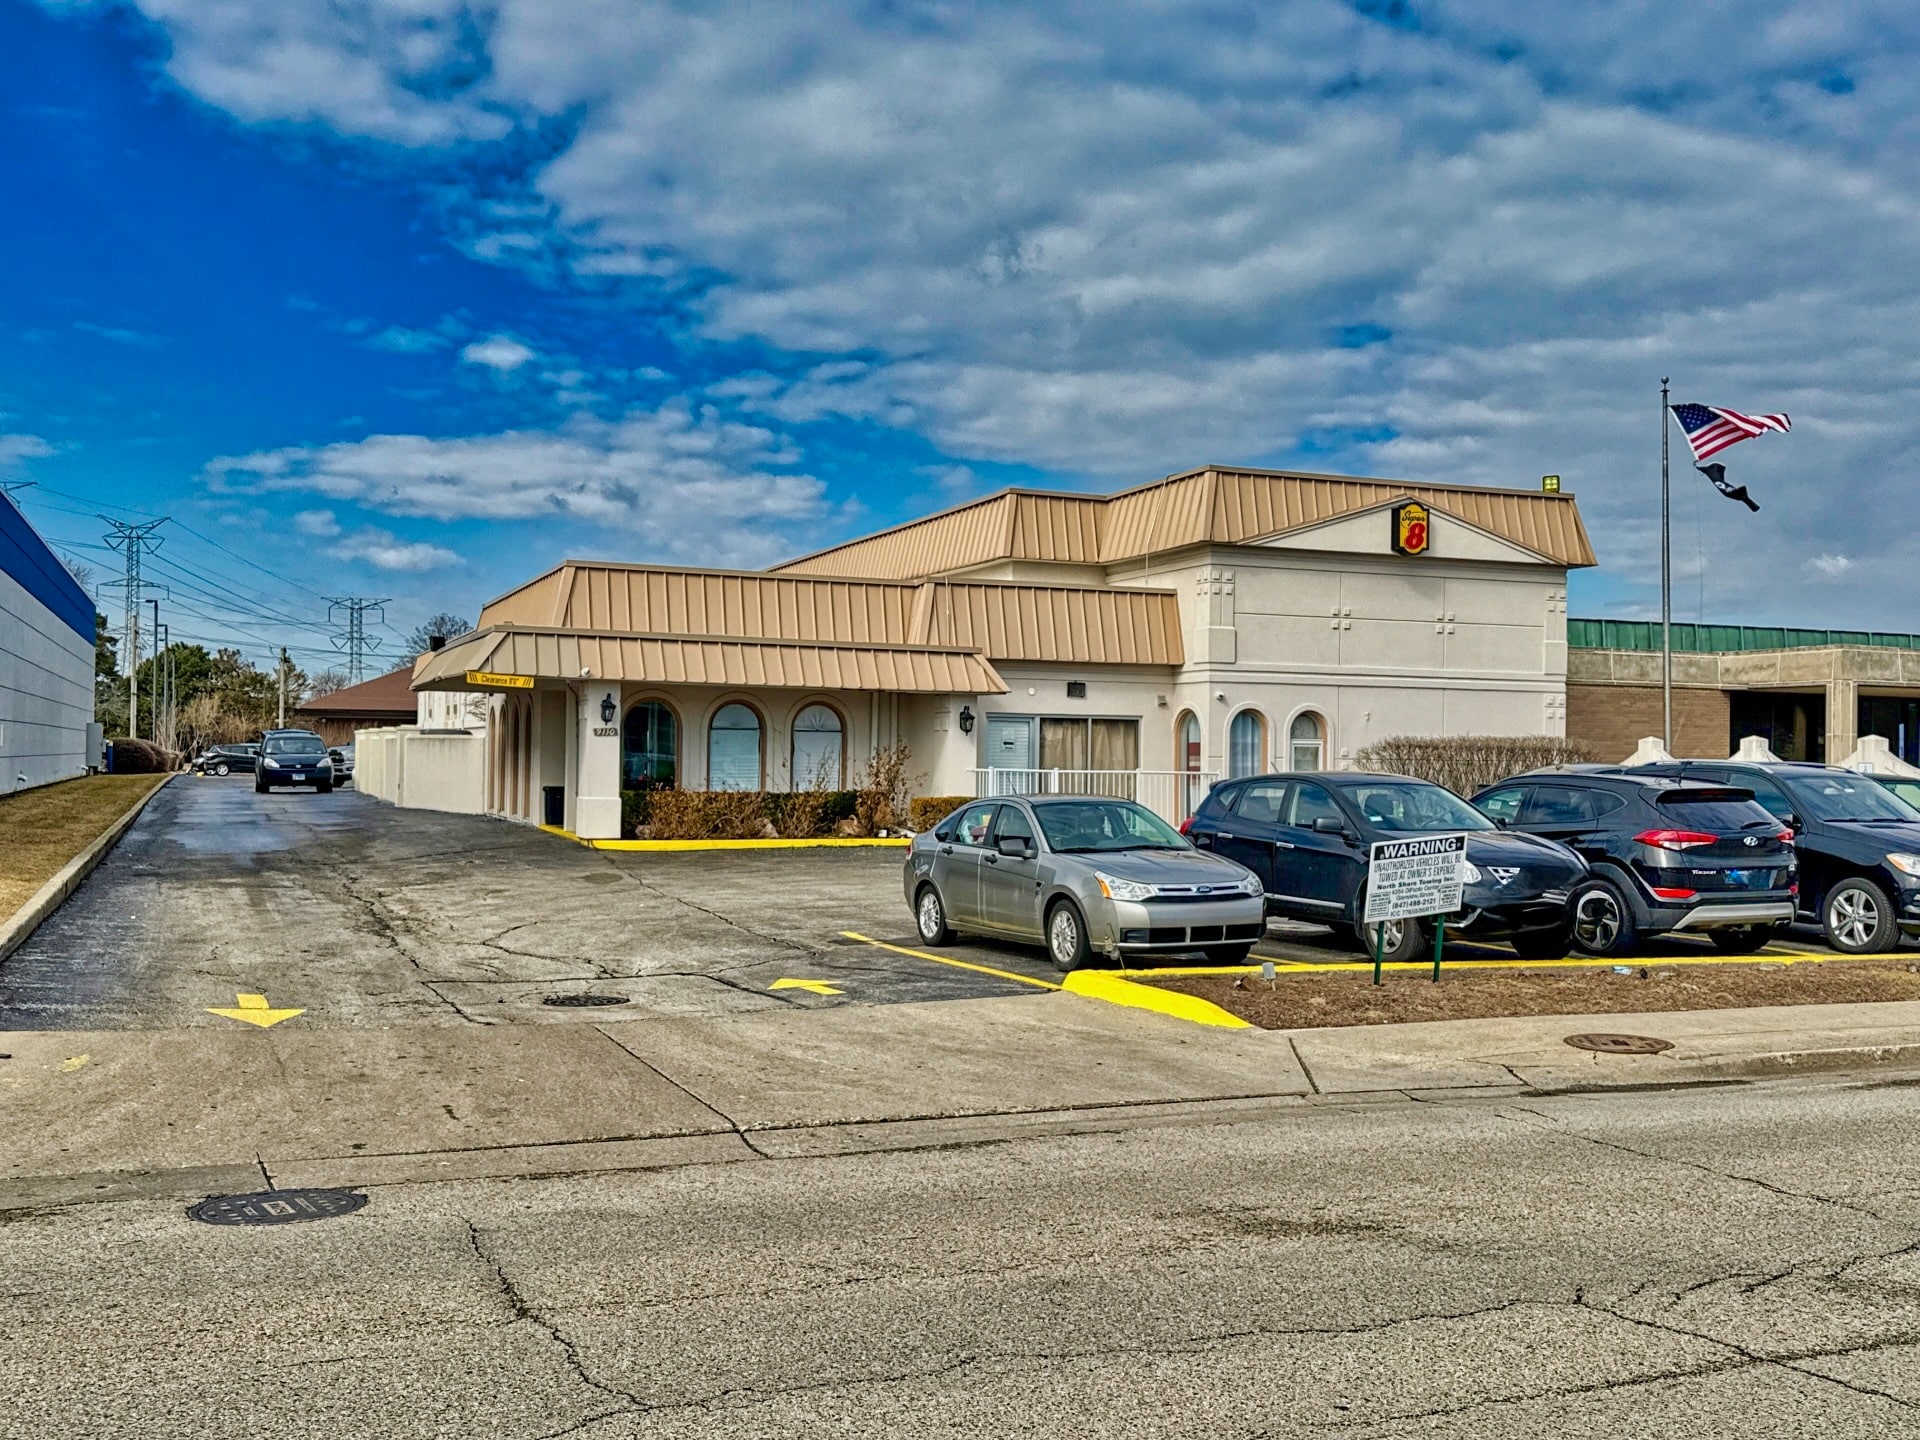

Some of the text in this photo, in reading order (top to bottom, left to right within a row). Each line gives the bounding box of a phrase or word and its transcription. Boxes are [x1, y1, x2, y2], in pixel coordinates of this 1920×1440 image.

[1401, 510, 1426, 526] Super
[1405, 522, 1426, 549] 8
[481, 674, 508, 685] Clearance
[1383, 838, 1457, 858] WARNING
[1374, 853, 1462, 873] UNAUTHORIZED VEHICLES WILL BE
[1378, 863, 1456, 883] TOWED AT OWNER'S EXPENSE
[1376, 882, 1396, 890] North
[1398, 880, 1417, 888] Shore
[1418, 878, 1442, 887] Towing
